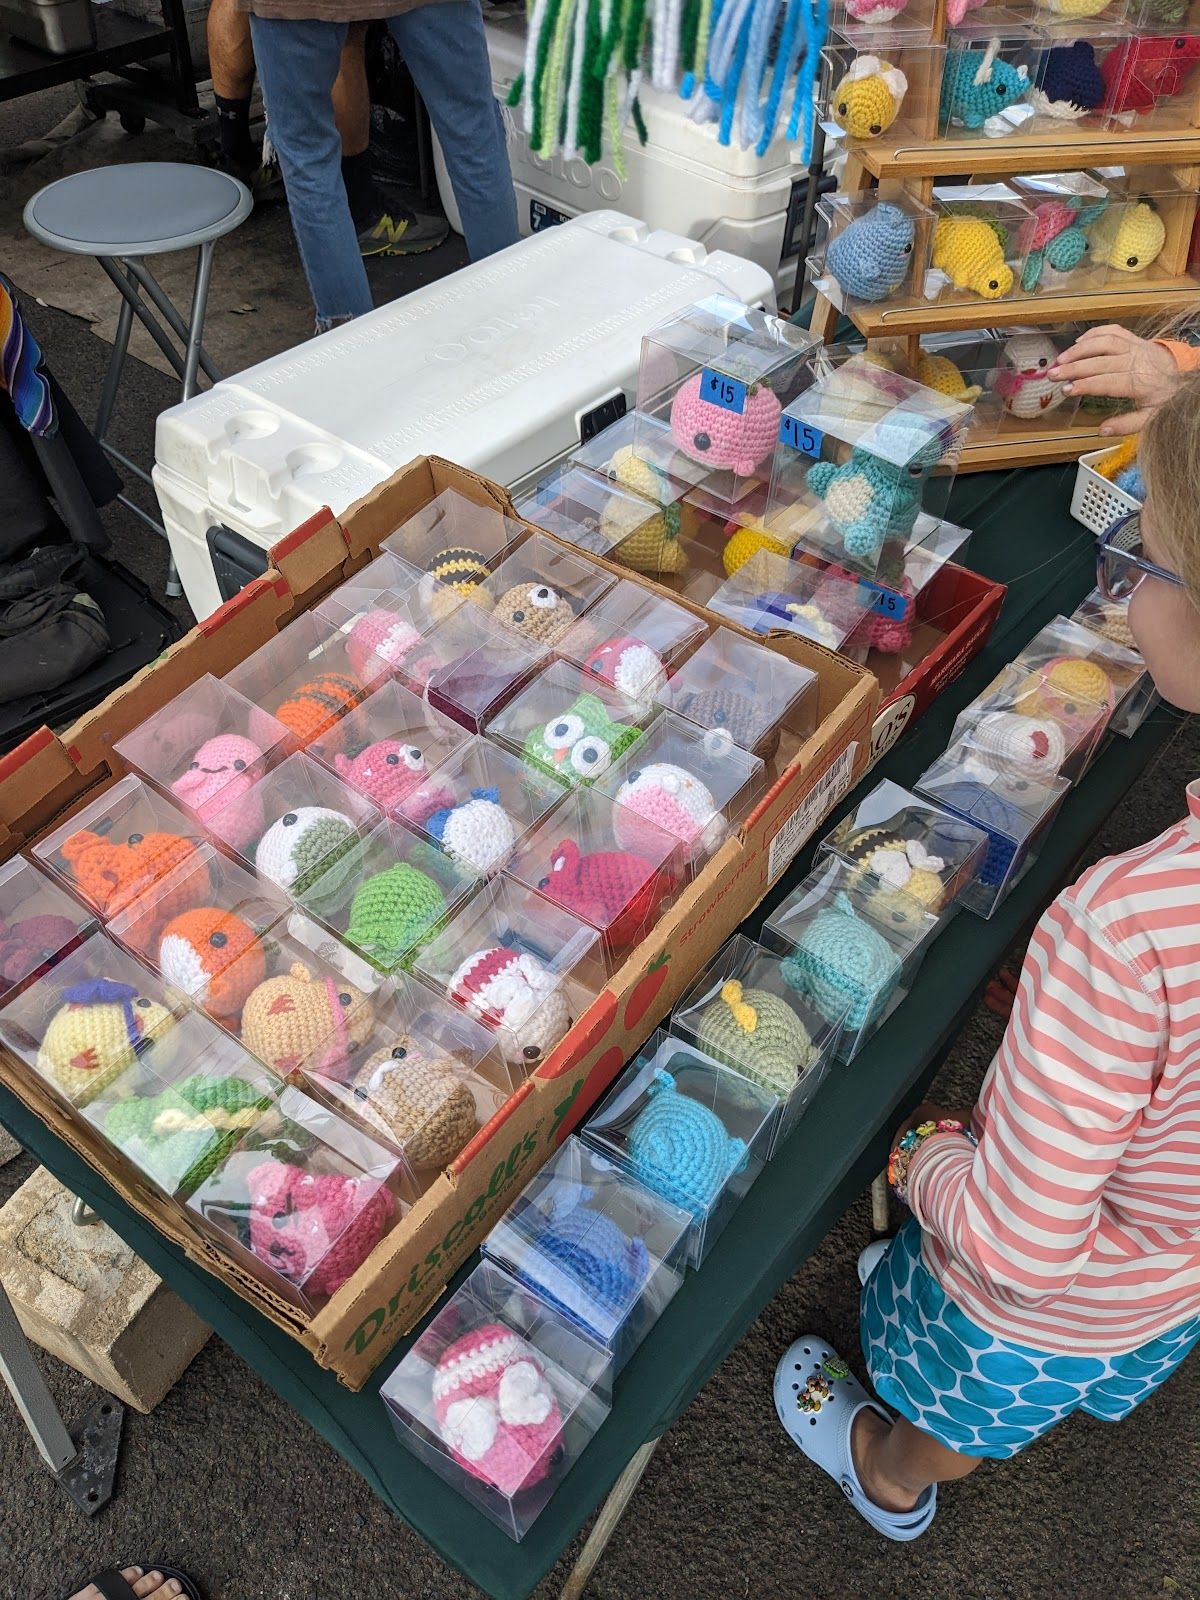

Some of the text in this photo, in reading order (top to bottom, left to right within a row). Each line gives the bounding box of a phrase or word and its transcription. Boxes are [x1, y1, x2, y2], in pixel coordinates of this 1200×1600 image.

[710, 376, 735, 404] $15
[784, 419, 815, 452] $15
[679, 851, 757, 948] Strawberries
[343, 1130, 538, 1356] Driscoll's
[380, 1300, 411, 1336] Only
